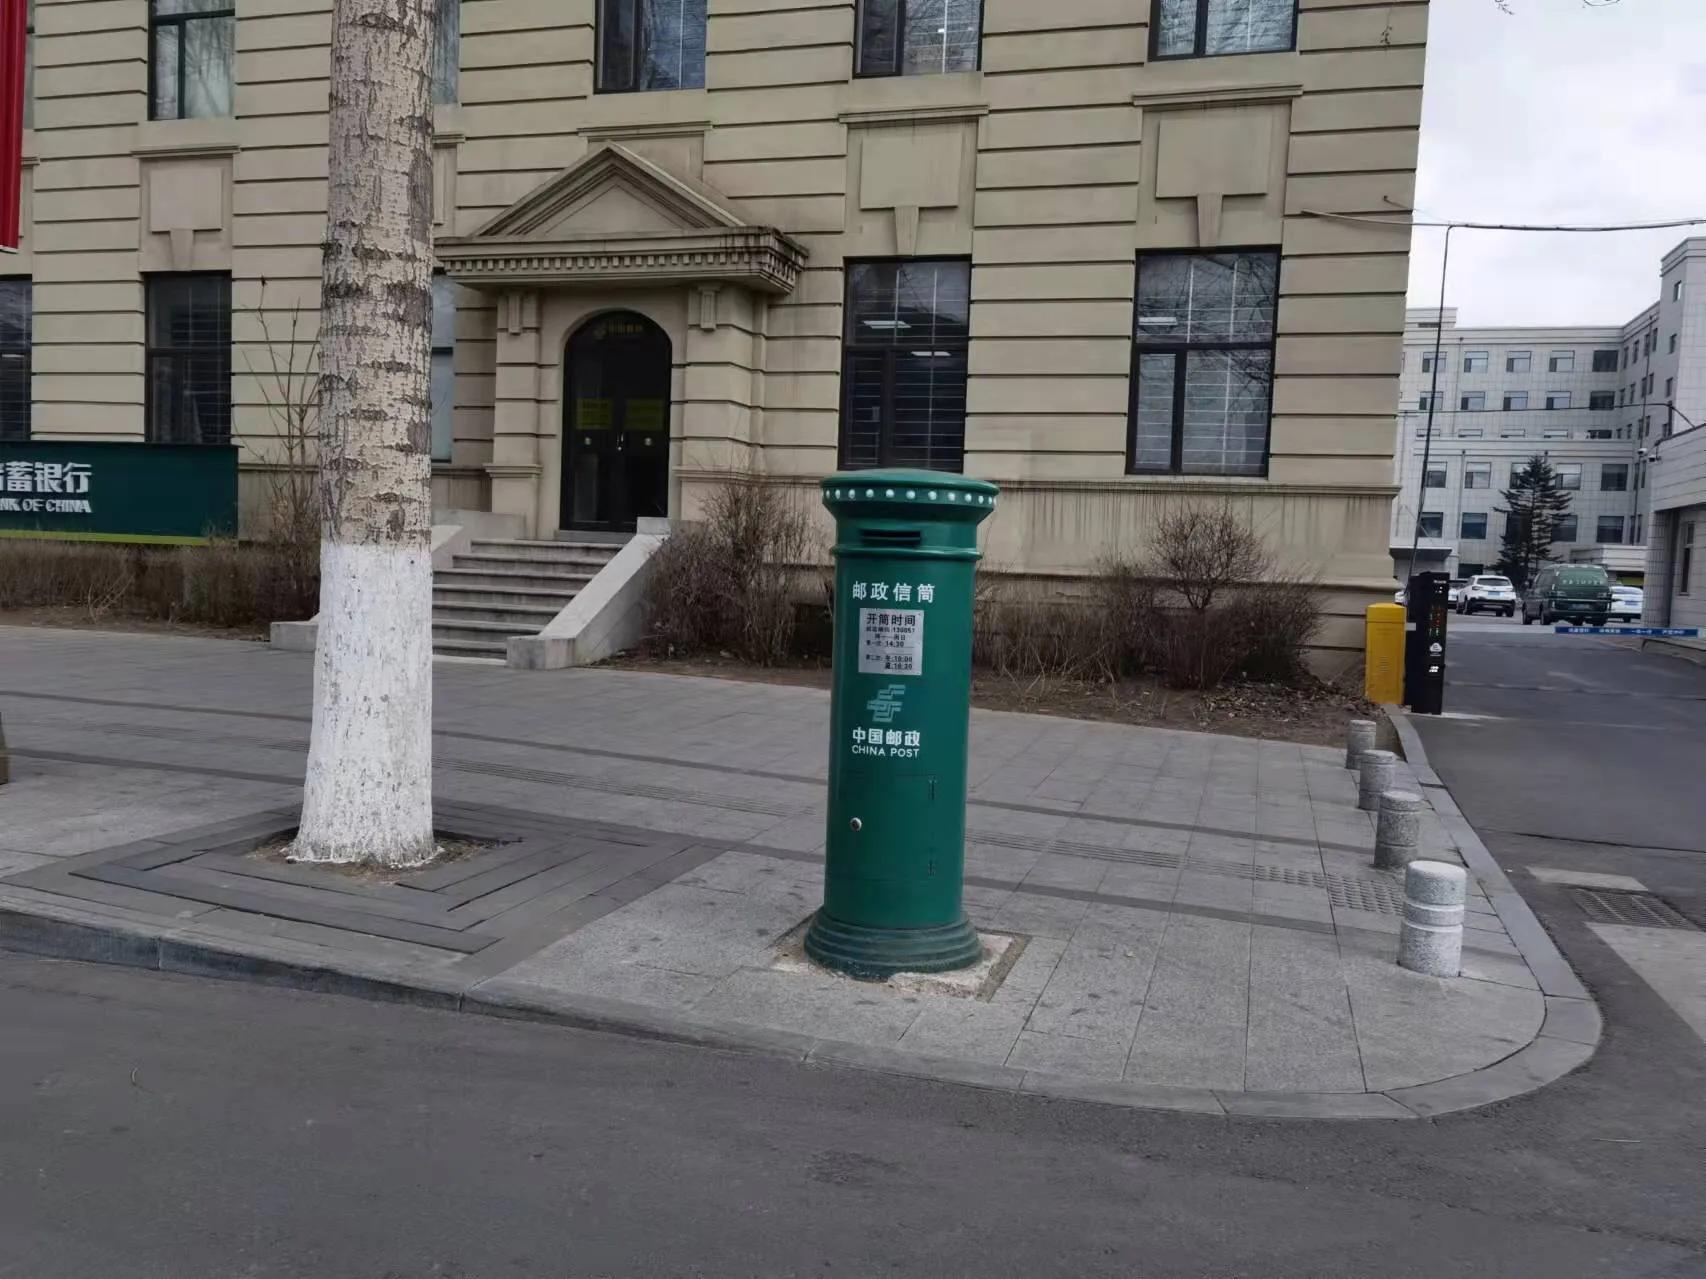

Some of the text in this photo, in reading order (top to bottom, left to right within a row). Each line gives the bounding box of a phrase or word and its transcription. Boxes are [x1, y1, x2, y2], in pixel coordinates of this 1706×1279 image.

[0, 461, 92, 493] 蓄银行
[22, 498, 44, 512] OF
[45, 499, 93, 513] CHINA
[852, 581, 935, 603] 邮政信筒
[866, 613, 916, 626] 开筒时间
[852, 726, 920, 746] 中国邮政
[851, 744, 920, 758] CHINA POST
